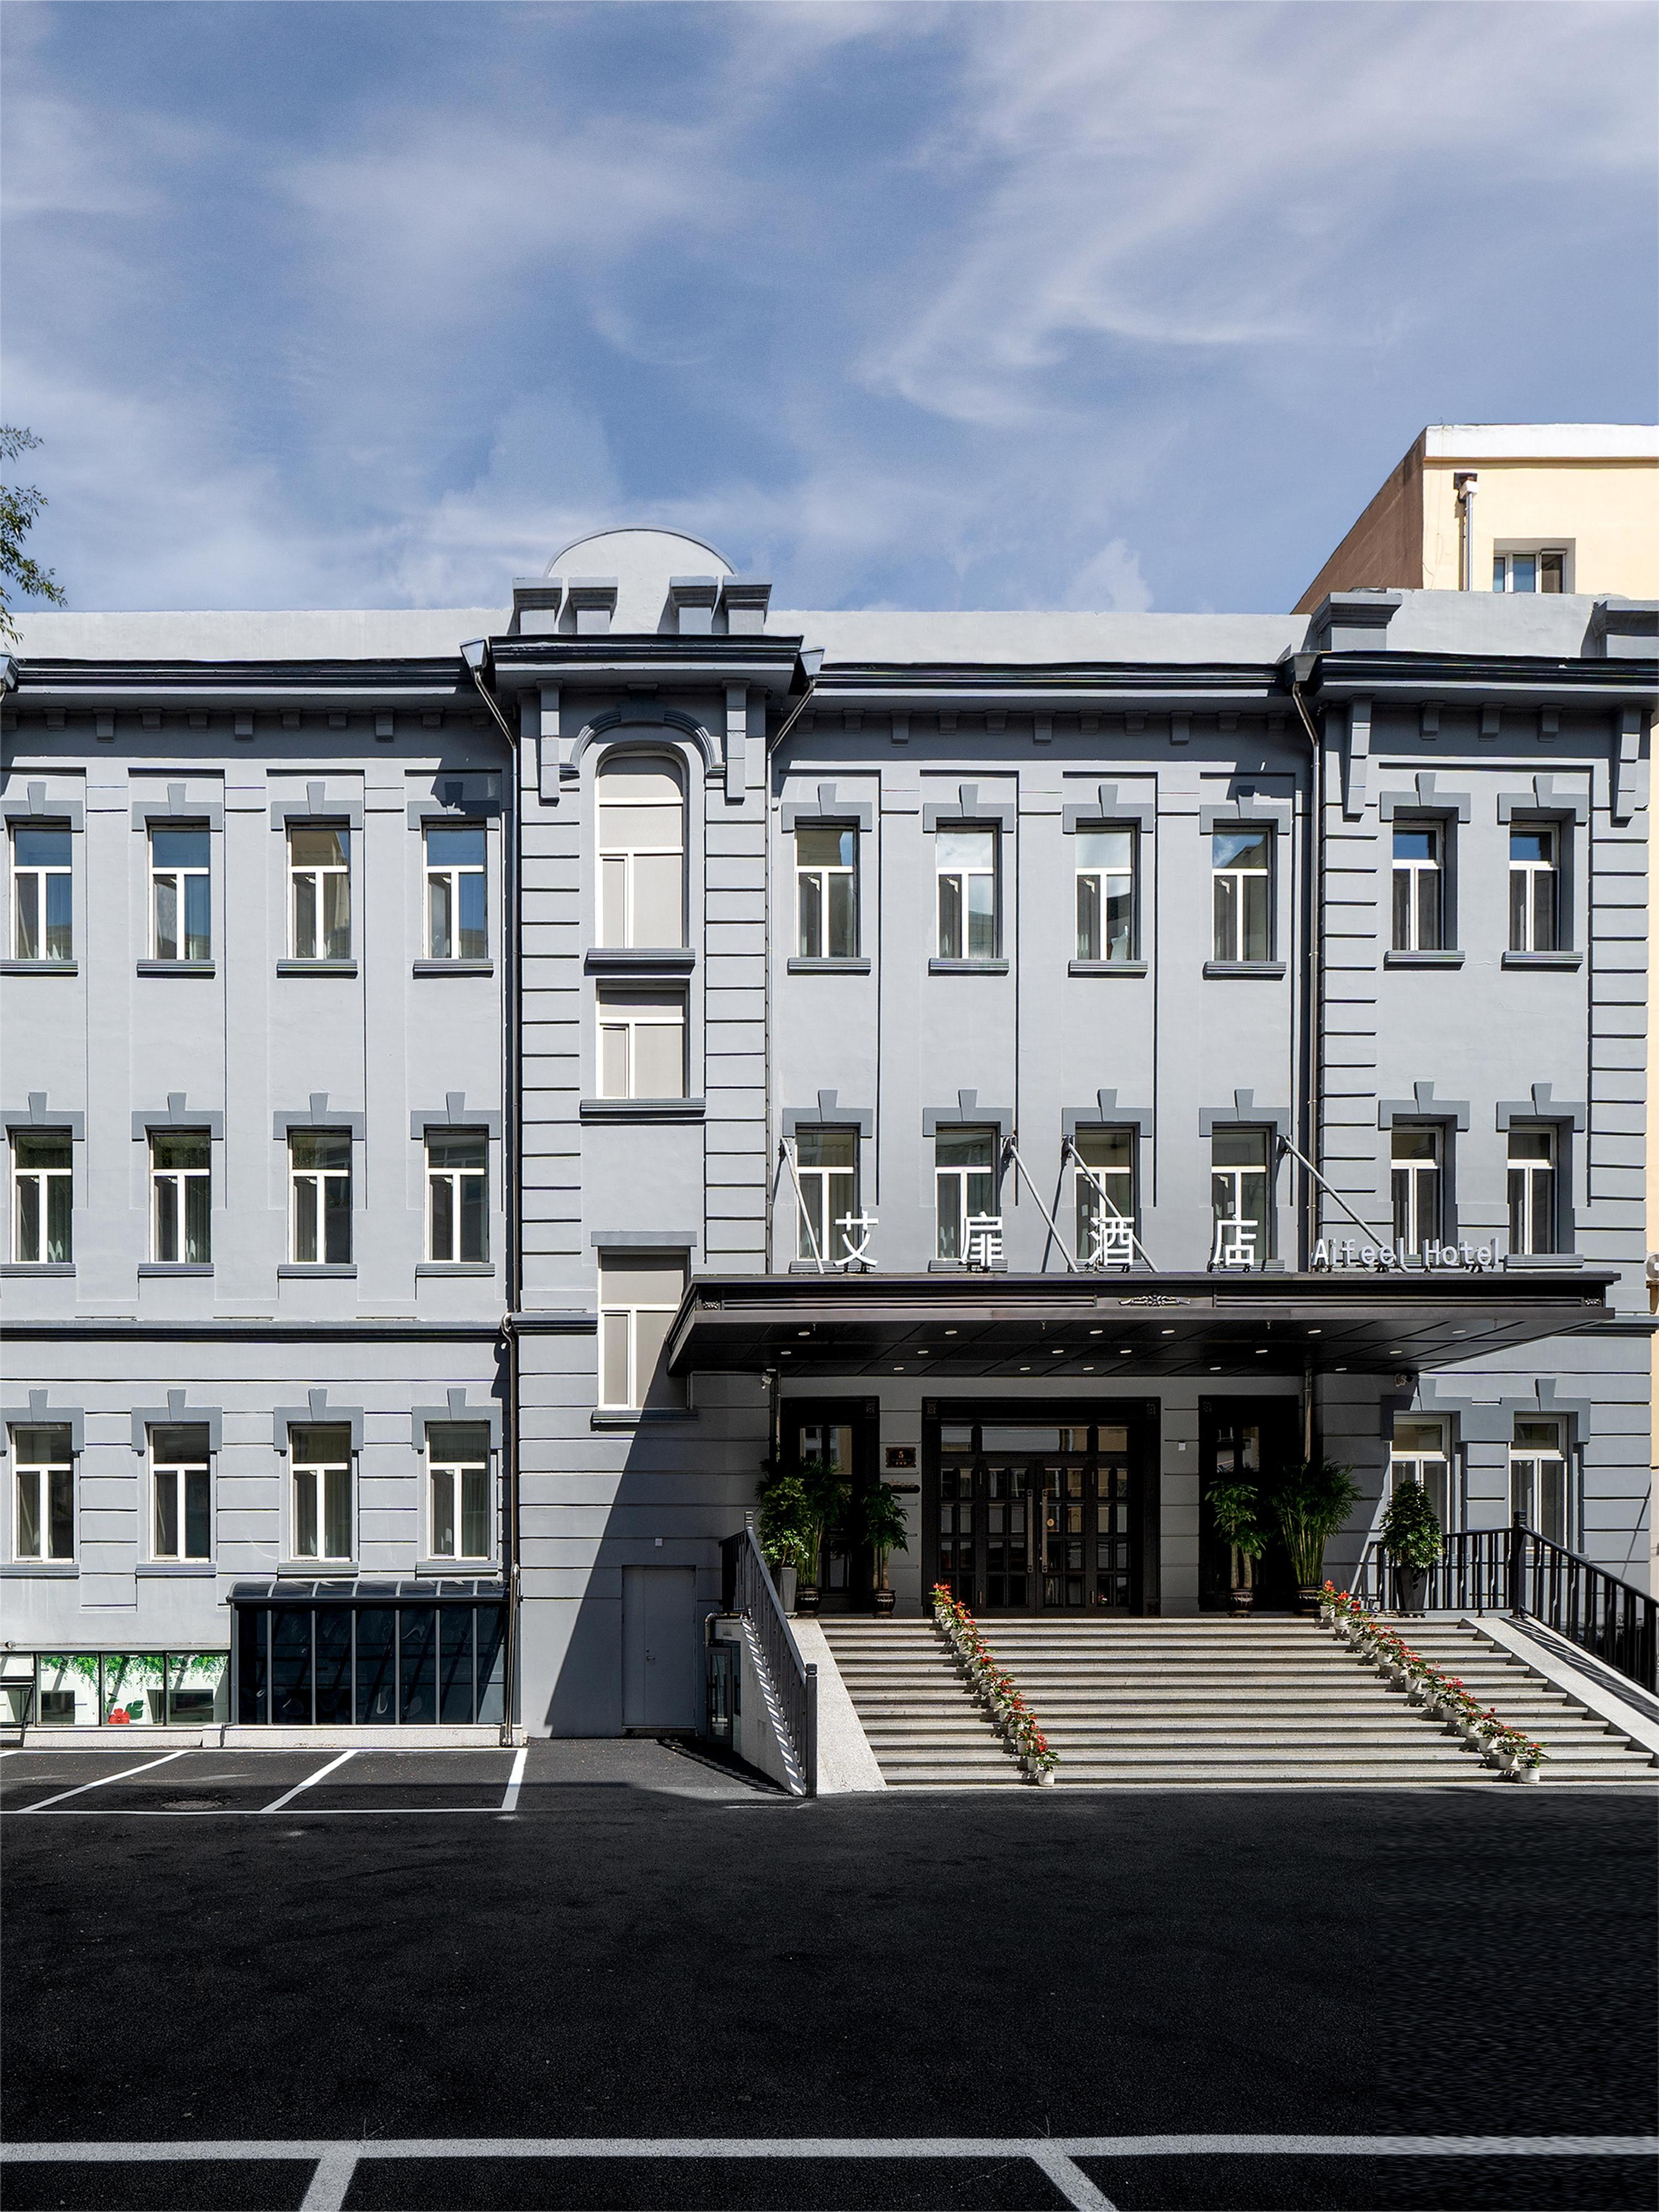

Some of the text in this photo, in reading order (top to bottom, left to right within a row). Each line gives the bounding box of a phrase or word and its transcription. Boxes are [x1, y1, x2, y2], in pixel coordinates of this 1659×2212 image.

[834, 1211, 1258, 1267] 艾扉酒店
[1312, 1237, 1499, 1266] Aifeel Hotel
